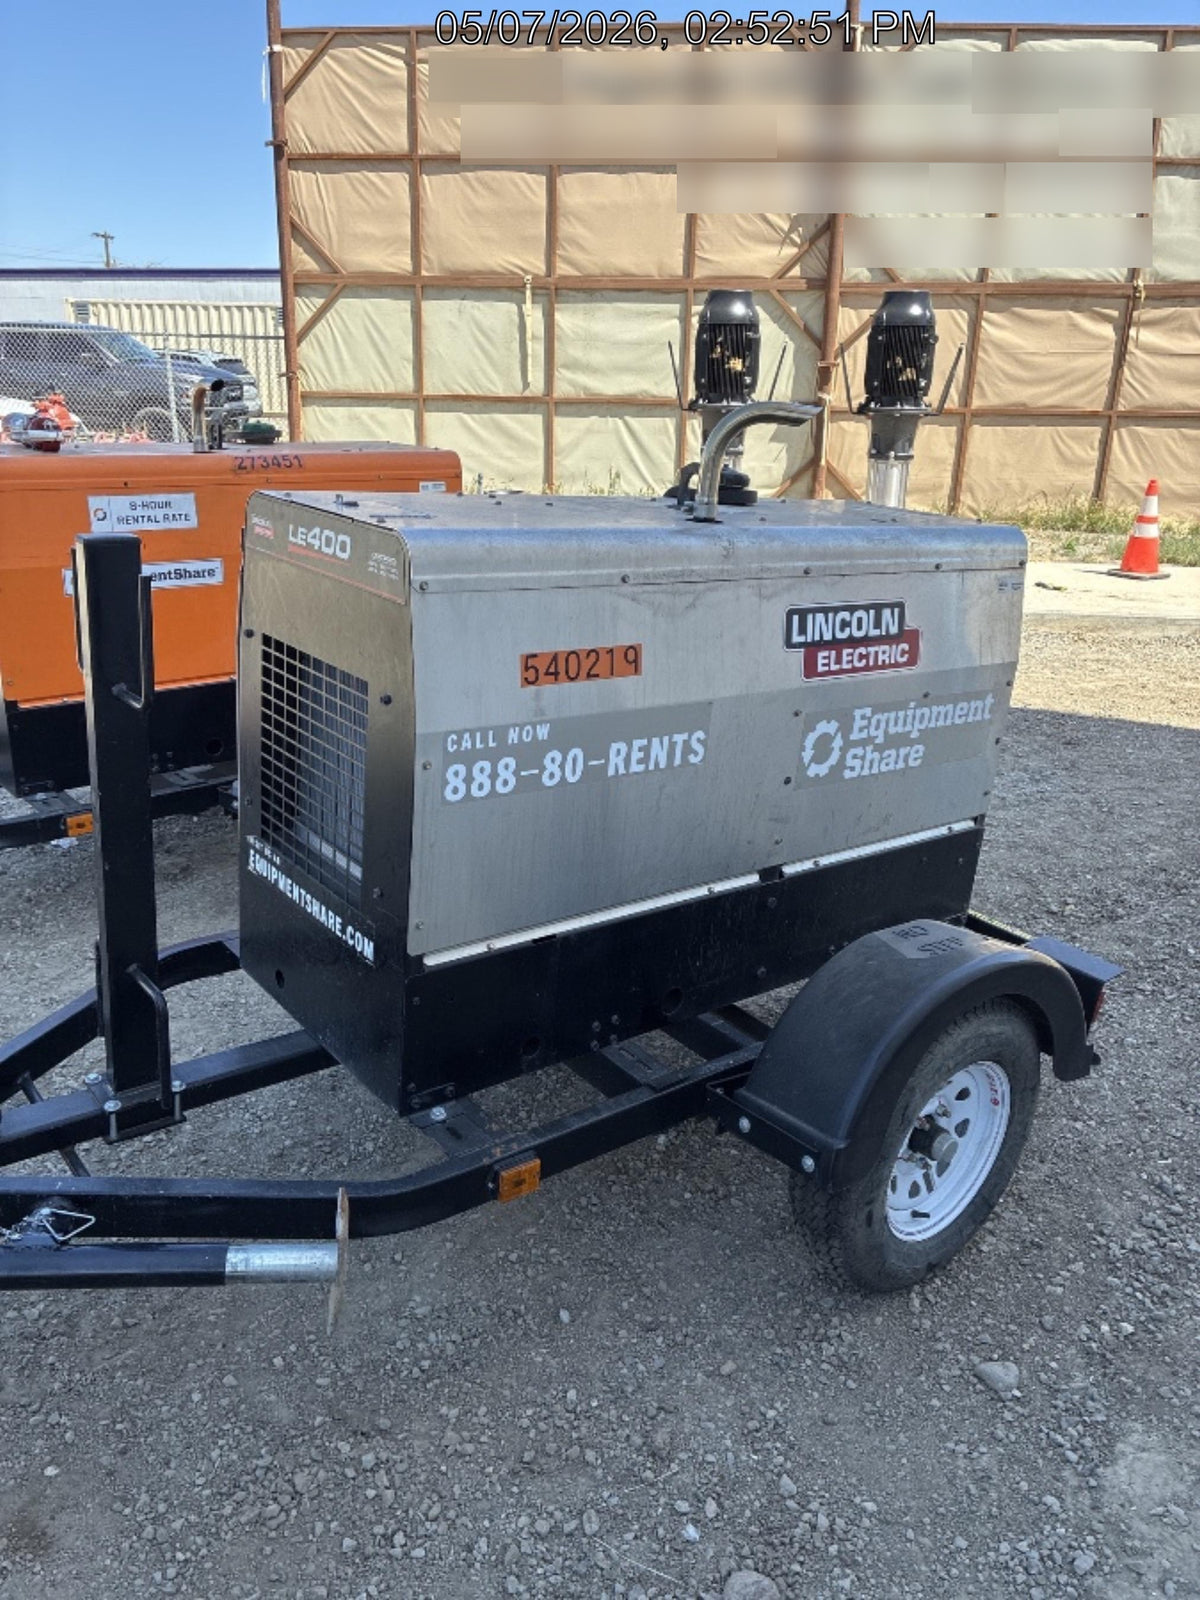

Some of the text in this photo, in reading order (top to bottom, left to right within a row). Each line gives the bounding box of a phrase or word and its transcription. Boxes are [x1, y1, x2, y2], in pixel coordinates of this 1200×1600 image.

[234, 454, 303, 470] 273451
[116, 512, 191, 525] RENTAL RATE
[129, 500, 173, 511] 8-HOUR
[288, 524, 351, 561] LE400
[791, 607, 900, 643] LINCOLN
[523, 645, 639, 686] 540219
[817, 643, 910, 673] ELECTRIC
[849, 692, 995, 744] Equipment
[447, 722, 551, 753] CALL NOW
[443, 730, 707, 802] 888-80-RENTS
[843, 743, 925, 779] Share
[248, 848, 375, 962] EQUIPMENTSHARE.COM
